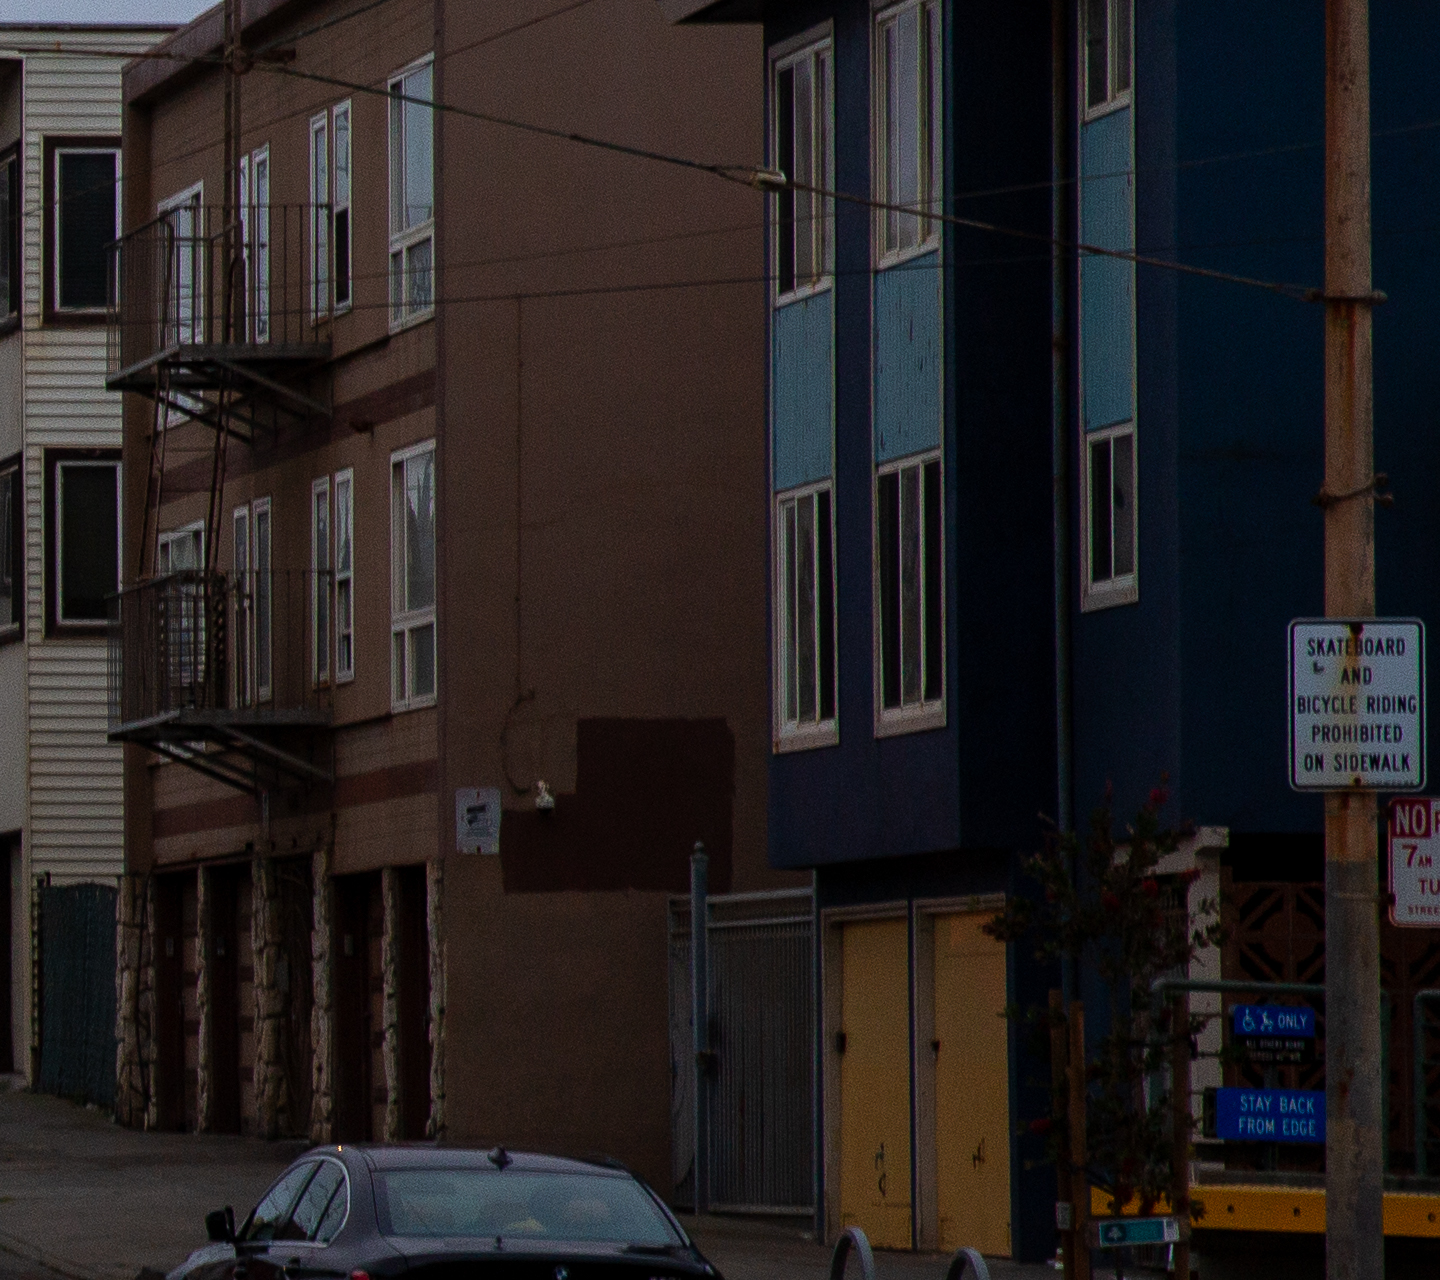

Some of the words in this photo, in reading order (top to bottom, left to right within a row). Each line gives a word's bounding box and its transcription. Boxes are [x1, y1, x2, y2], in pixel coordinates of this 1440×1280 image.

[1307, 637, 1406, 657] SKATEBOARD
[1341, 667, 1373, 685] AND
[1297, 695, 1358, 714] BICYCLE
[1366, 695, 1417, 714] RIDING
[1312, 724, 1403, 743] PROHIBITED
[1304, 753, 1325, 772] ON
[1333, 752, 1411, 772] SIDEWALK
[1395, 803, 1427, 836] NO
[1278, 1013, 1308, 1030] ONLY
[1240, 1094, 1273, 1112] STAY
[1280, 1095, 1315, 1115] BACK
[1238, 1116, 1276, 1136] FROM
[1282, 1117, 1317, 1137] EDGE
